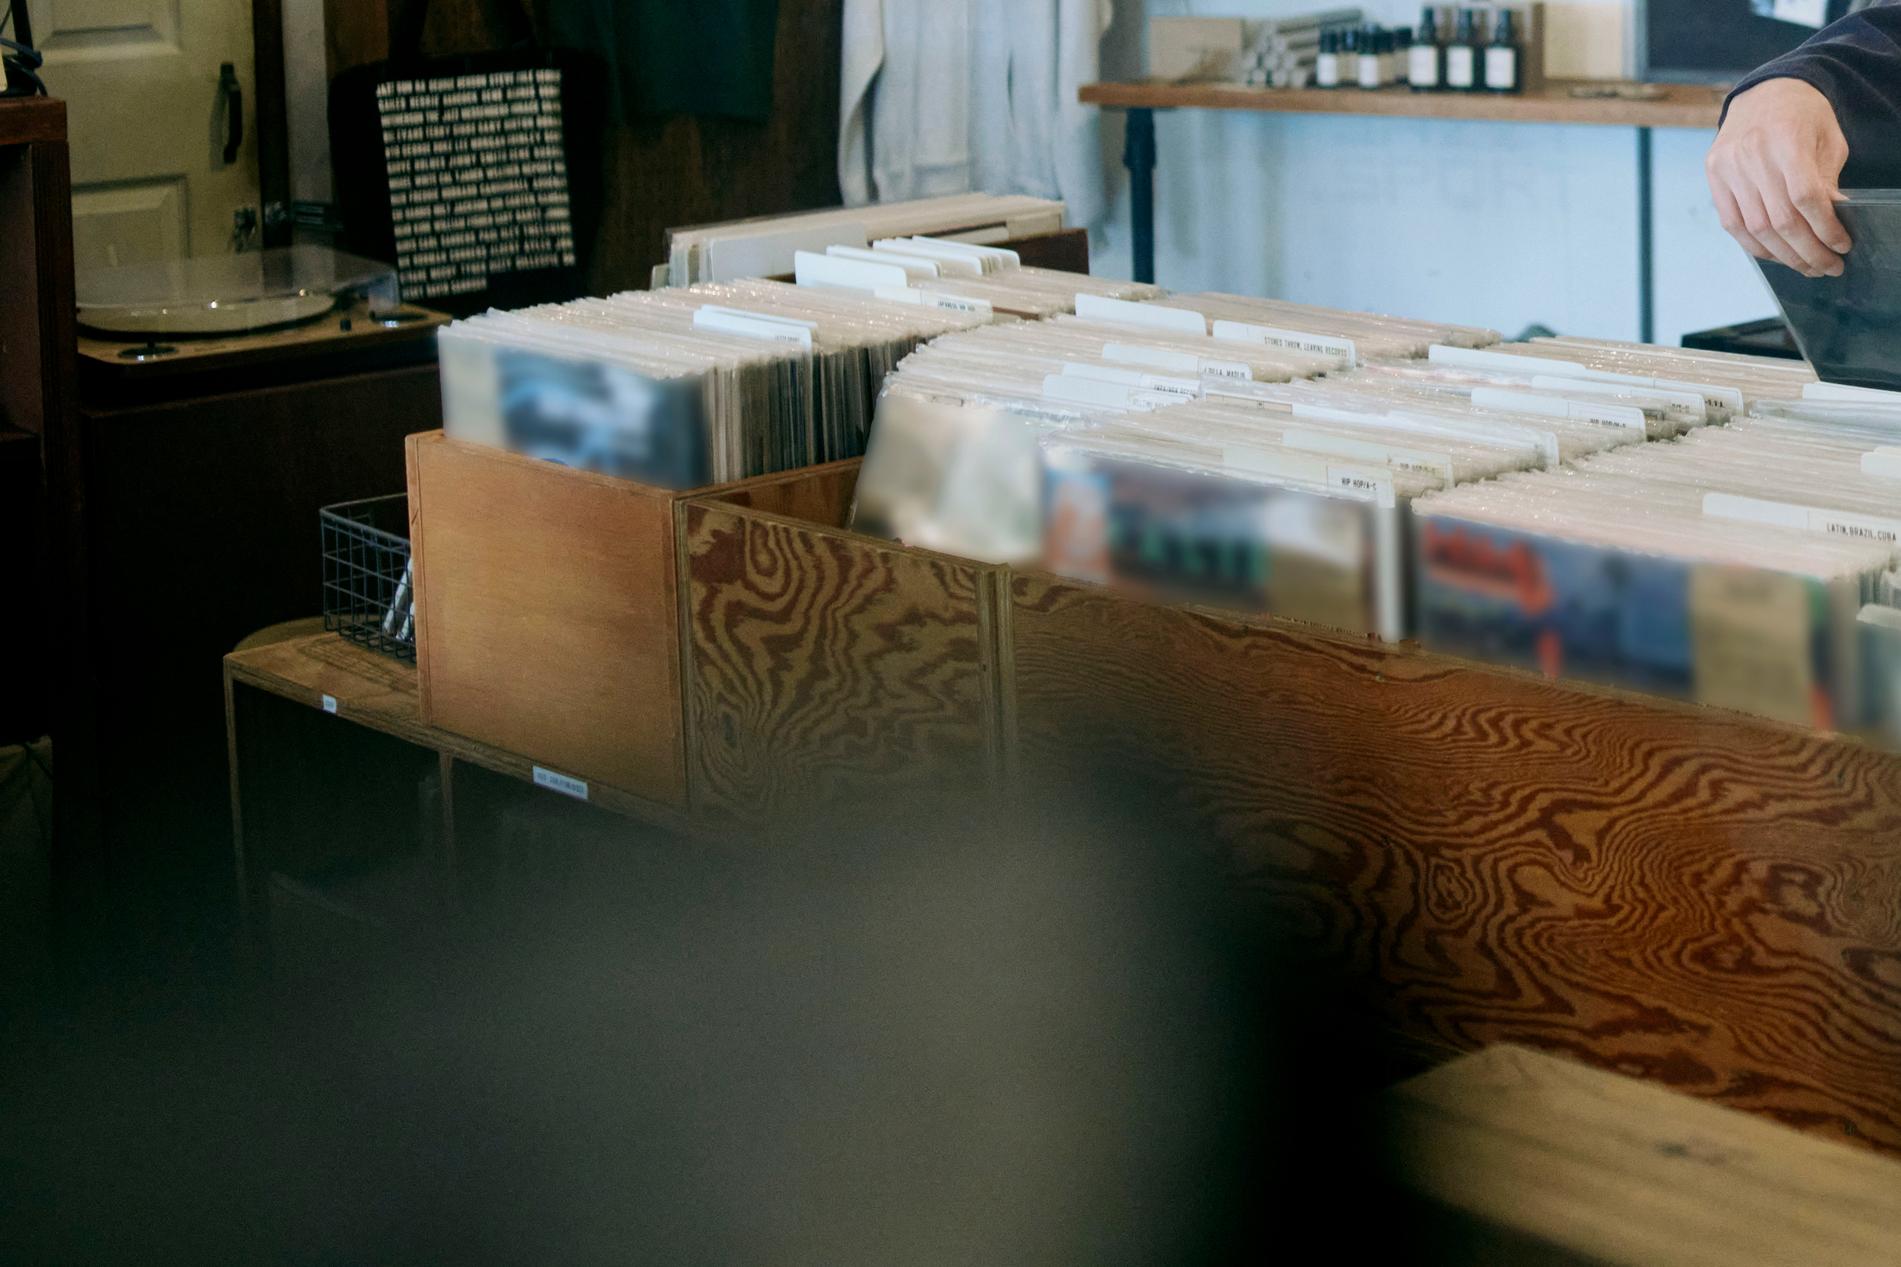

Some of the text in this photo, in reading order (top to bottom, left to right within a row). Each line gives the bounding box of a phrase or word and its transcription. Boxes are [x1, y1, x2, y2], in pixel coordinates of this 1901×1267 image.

[1264, 336, 1283, 348] STONES
[1304, 342, 1324, 355] LEAVING
[1325, 345, 1348, 358] RECORDS
[1341, 477, 1377, 492] HIP HOP/A-C
